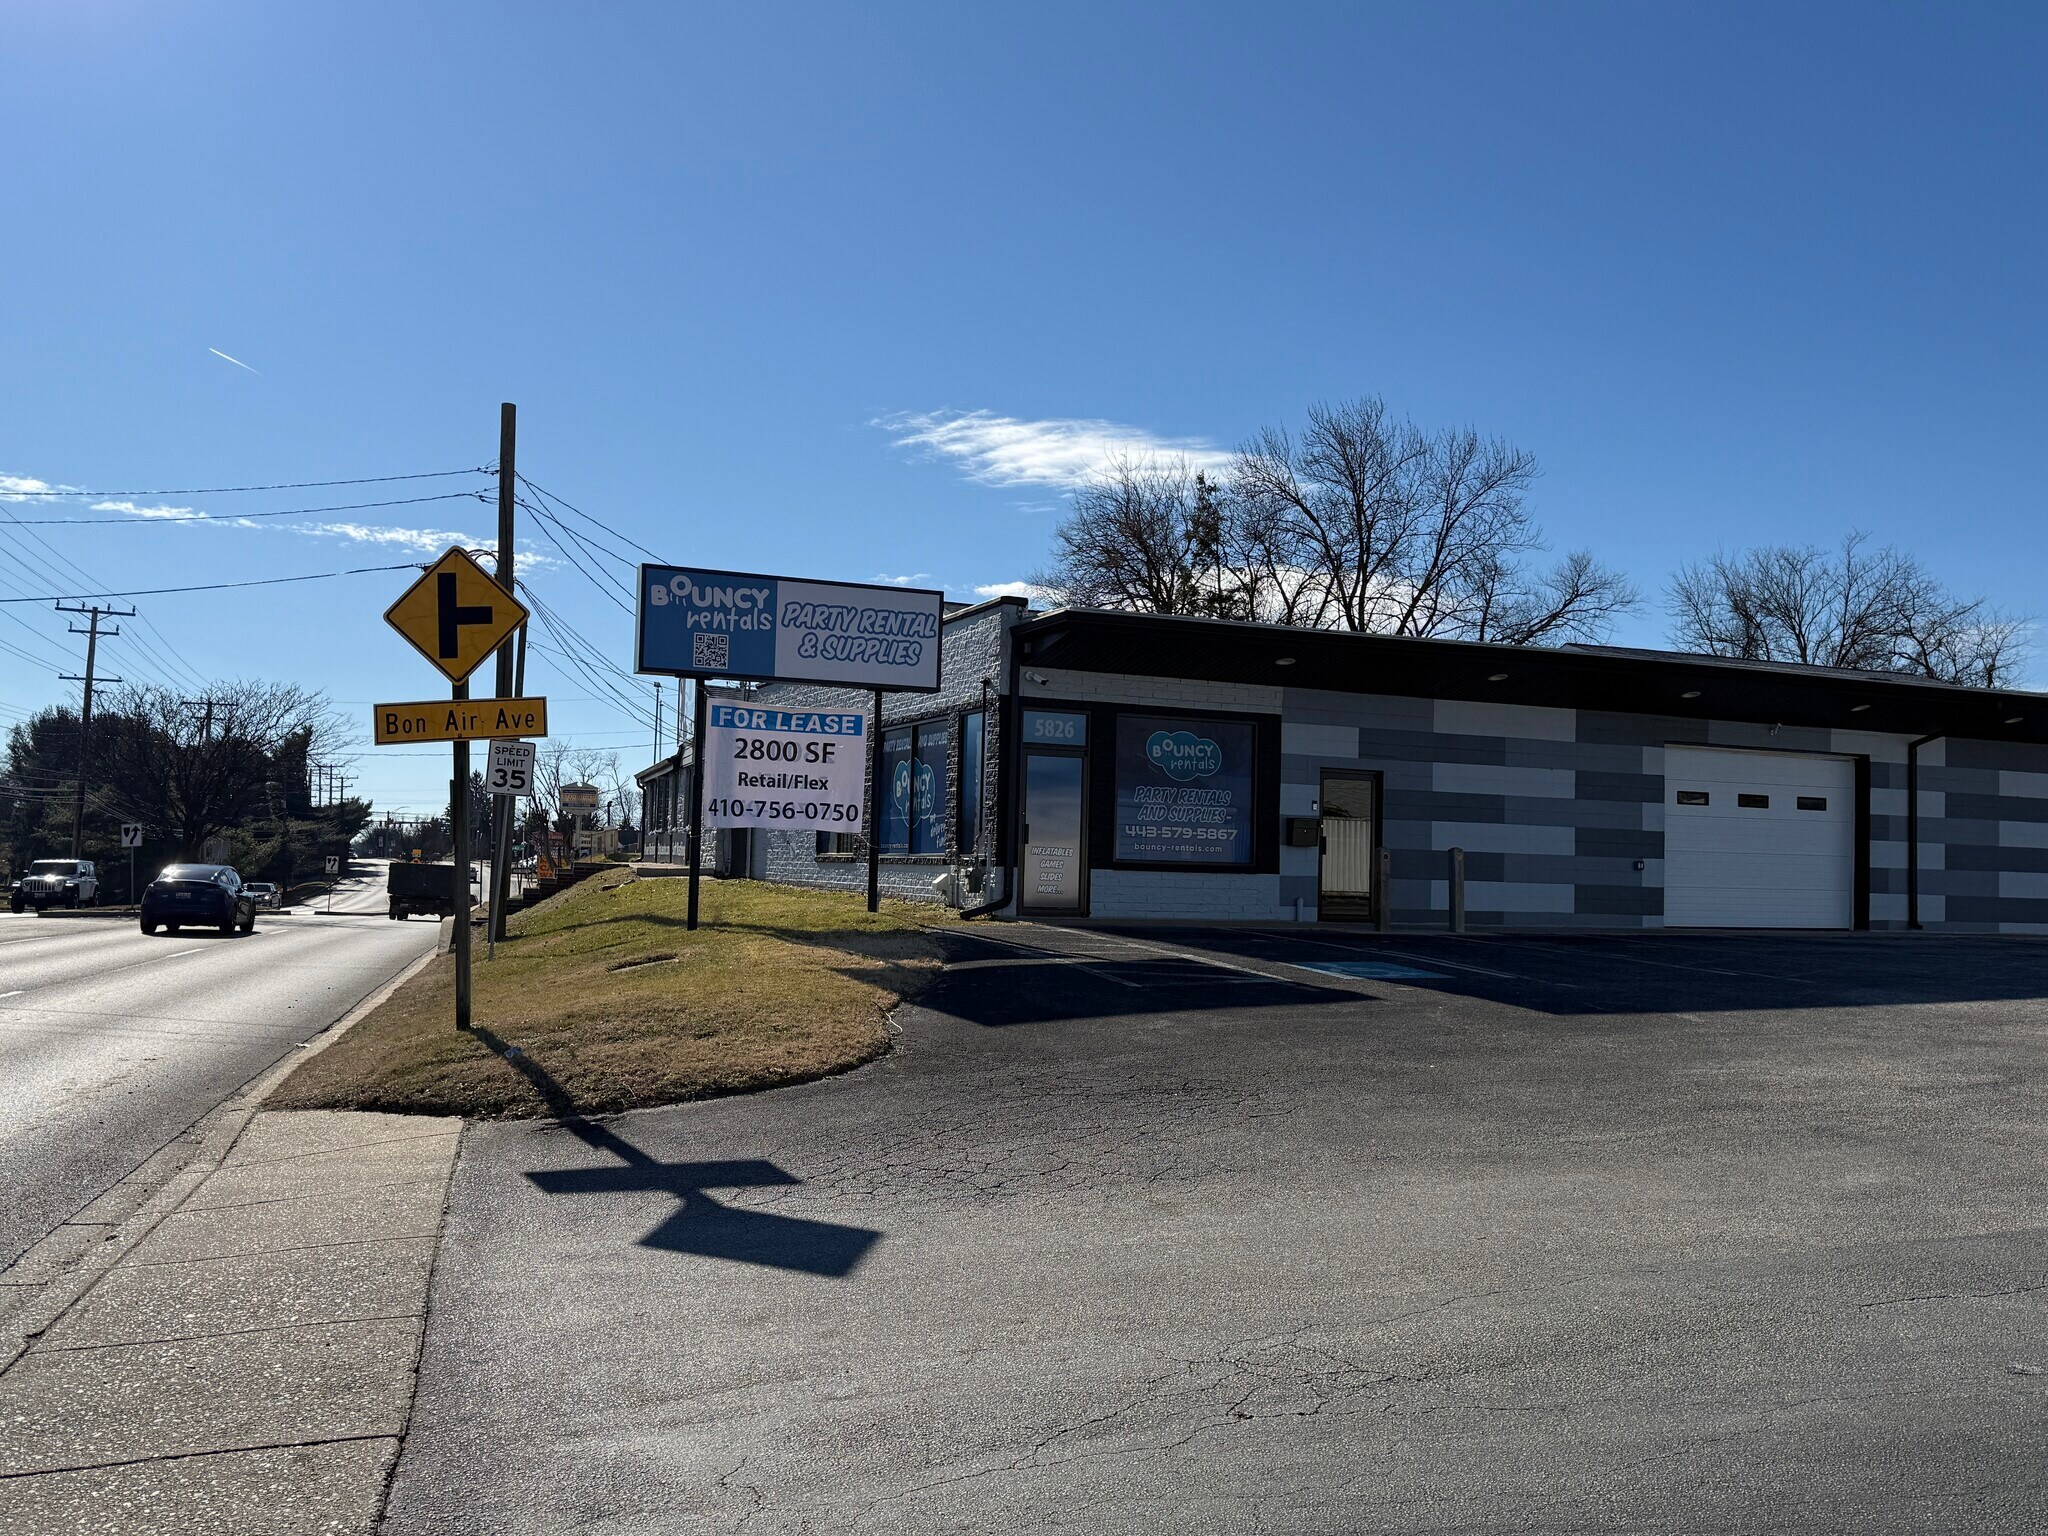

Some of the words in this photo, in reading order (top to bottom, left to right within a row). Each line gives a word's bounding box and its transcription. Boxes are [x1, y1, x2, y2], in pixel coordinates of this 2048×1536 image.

[651, 575, 770, 609] BOUNCY
[687, 607, 772, 632] rentals
[781, 601, 858, 633] PARTY
[857, 608, 937, 638] RENTAL
[798, 632, 818, 659] &
[820, 634, 922, 667] SUPPLIES
[385, 712, 426, 735] Bon
[445, 709, 478, 732] Air
[496, 707, 535, 730] Ave
[718, 707, 767, 729] FOR
[775, 712, 856, 734] LEASE
[1034, 719, 1075, 738] 5826
[494, 745, 530, 757] SPEED
[733, 738, 798, 762] 2800
[805, 742, 836, 764] SF
[1152, 739, 1213, 757] BOUNCY
[496, 757, 526, 768] LIMIT
[1170, 756, 1216, 771] rentals
[491, 768, 526, 790] 35
[738, 772, 829, 790] Retail/Flex
[1134, 786, 1177, 804] PARTY
[1178, 788, 1232, 806] RENTALS
[708, 798, 859, 822] 410-756-0750
[1138, 804, 1168, 821] AND
[1125, 825, 1238, 840] 443-579-5867
[1031, 846, 1074, 857] INFLATABLES
[1134, 842, 1223, 853] bouncy-rentals.com
[1040, 859, 1064, 869] GAMES
[1040, 872, 1063, 882] SLIDES
[1036, 884, 1064, 894] MORE...
